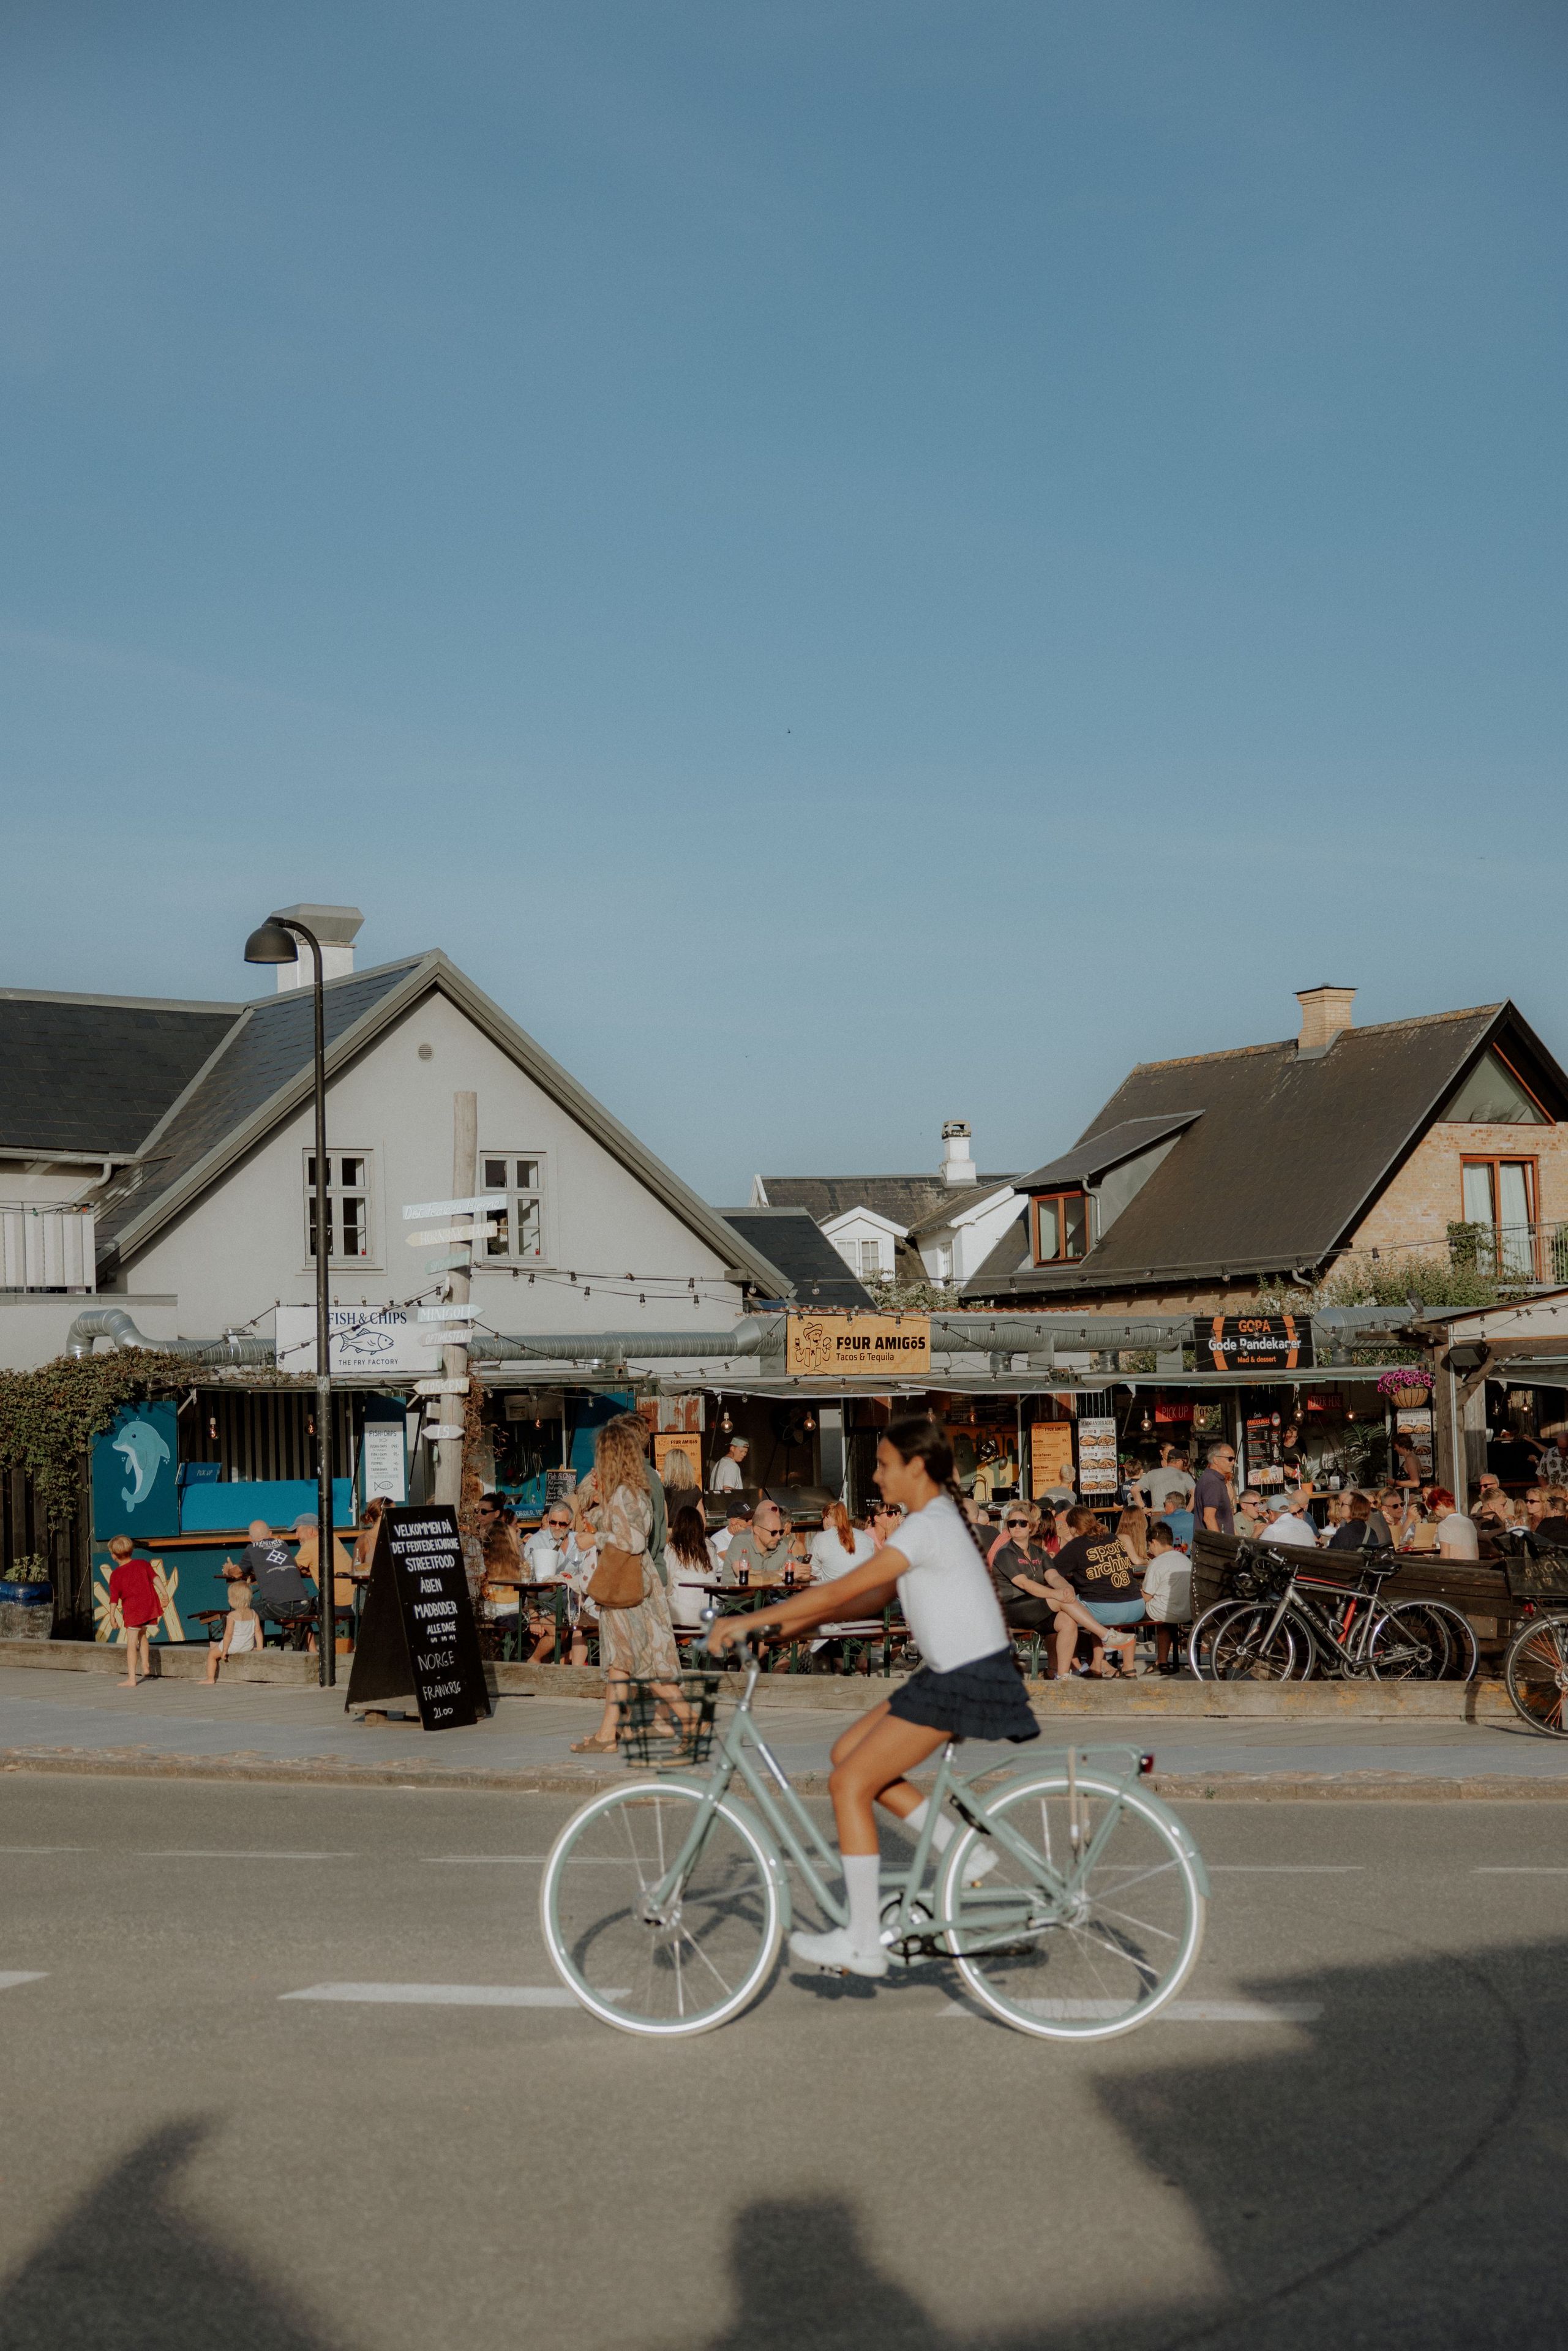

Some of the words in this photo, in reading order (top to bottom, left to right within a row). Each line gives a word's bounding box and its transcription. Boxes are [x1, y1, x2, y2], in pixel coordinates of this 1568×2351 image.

[329, 1312, 355, 1325] FISH
[358, 1313, 367, 1325] &
[370, 1312, 407, 1325] CHIPS
[1238, 1319, 1272, 1333] GOPA
[836, 1337, 870, 1349] FOUR
[1208, 1338, 1237, 1352] Gode
[836, 1352, 858, 1361] Tacos
[860, 1352, 866, 1361] &
[868, 1352, 895, 1363] Tequila
[1162, 1406, 1177, 1419] PICK
[1179, 1405, 1188, 1419] UP
[394, 1521, 441, 1537] VELKOMMEN
[441, 1518, 452, 1534] PÅ
[391, 1541, 405, 1554] DET
[405, 1539, 435, 1553] FEDTEDE
[434, 1537, 460, 1551] HJØRNE
[405, 1554, 456, 1572] STREETFOOD
[420, 1577, 443, 1594] ÅBEN
[1111, 1570, 1130, 1588] 08
[413, 1600, 458, 1620] MADBODER
[427, 1623, 441, 1635] ALLE
[441, 1620, 457, 1633] DAGE
[417, 1651, 455, 1671] NORGE
[422, 1681, 461, 1701] FRANKRIG
[433, 1707, 454, 1719] 21.00
